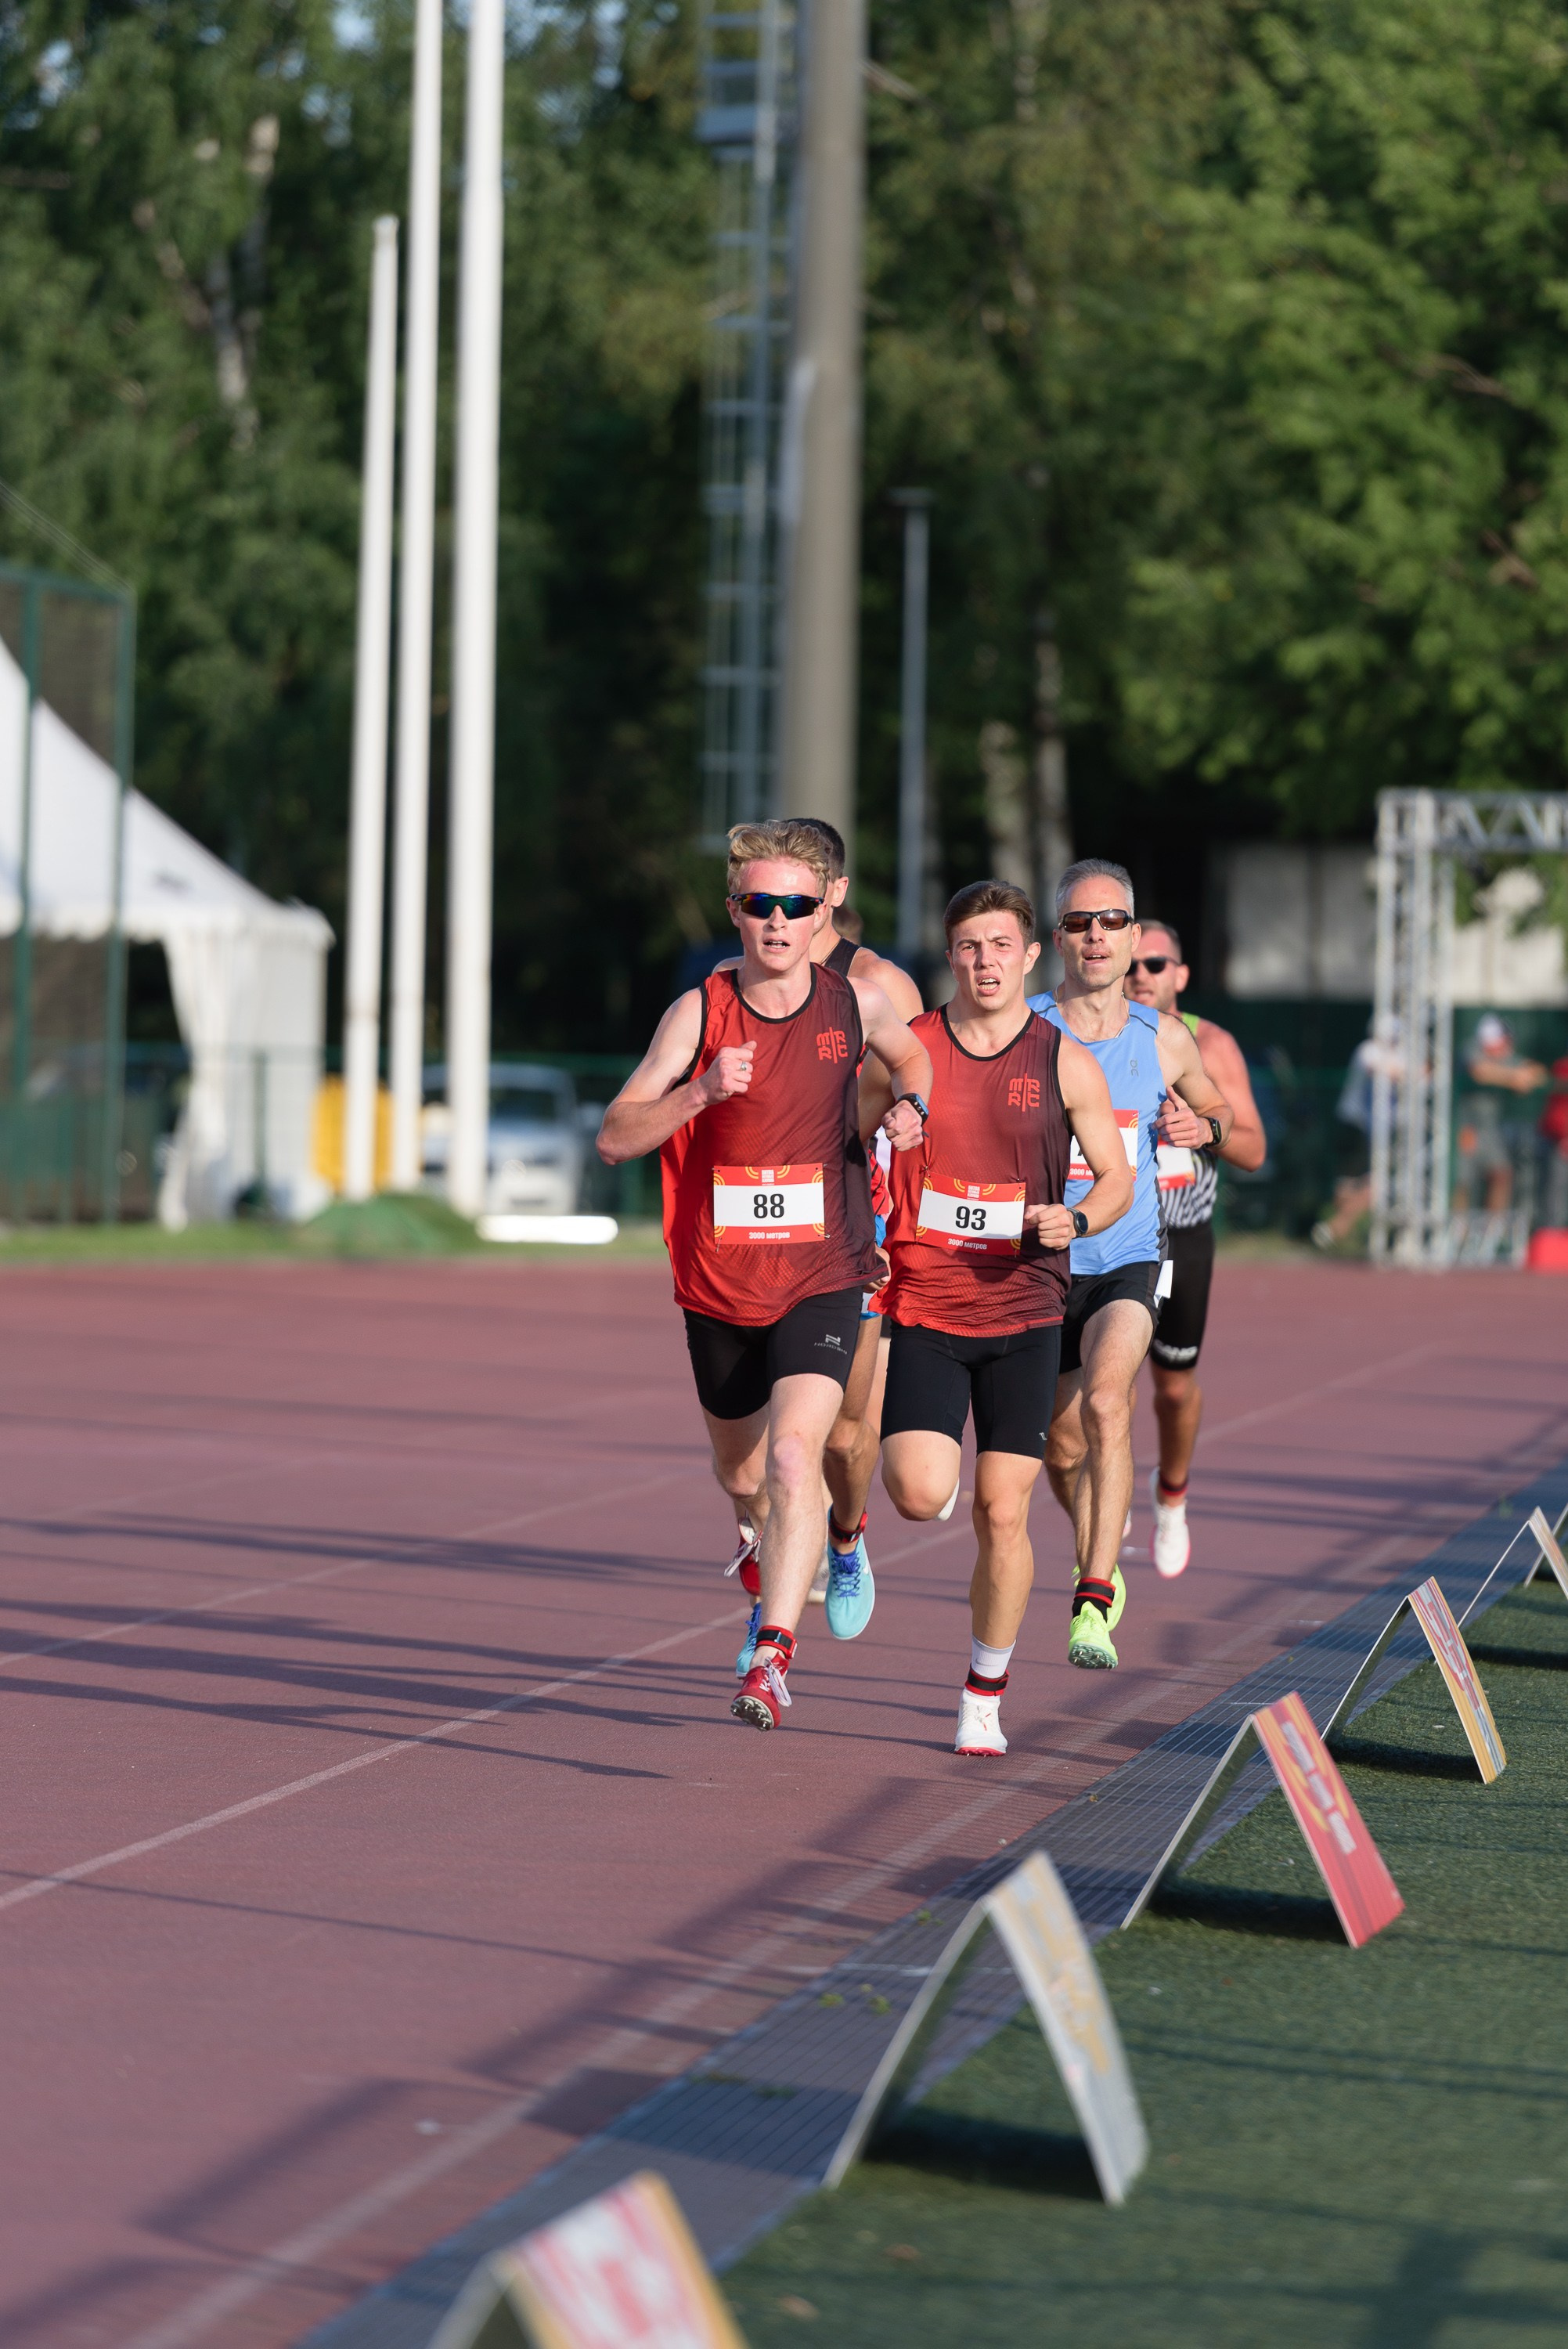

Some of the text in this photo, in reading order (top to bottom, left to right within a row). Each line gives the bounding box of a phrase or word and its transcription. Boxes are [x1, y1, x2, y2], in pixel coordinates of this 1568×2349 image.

[1069, 1167, 1085, 1176] 3000
[753, 1193, 785, 1219] 88
[955, 1205, 987, 1232] 93
[766, 1232, 791, 1240] метров
[947, 1237, 988, 1250] 3000 метров
